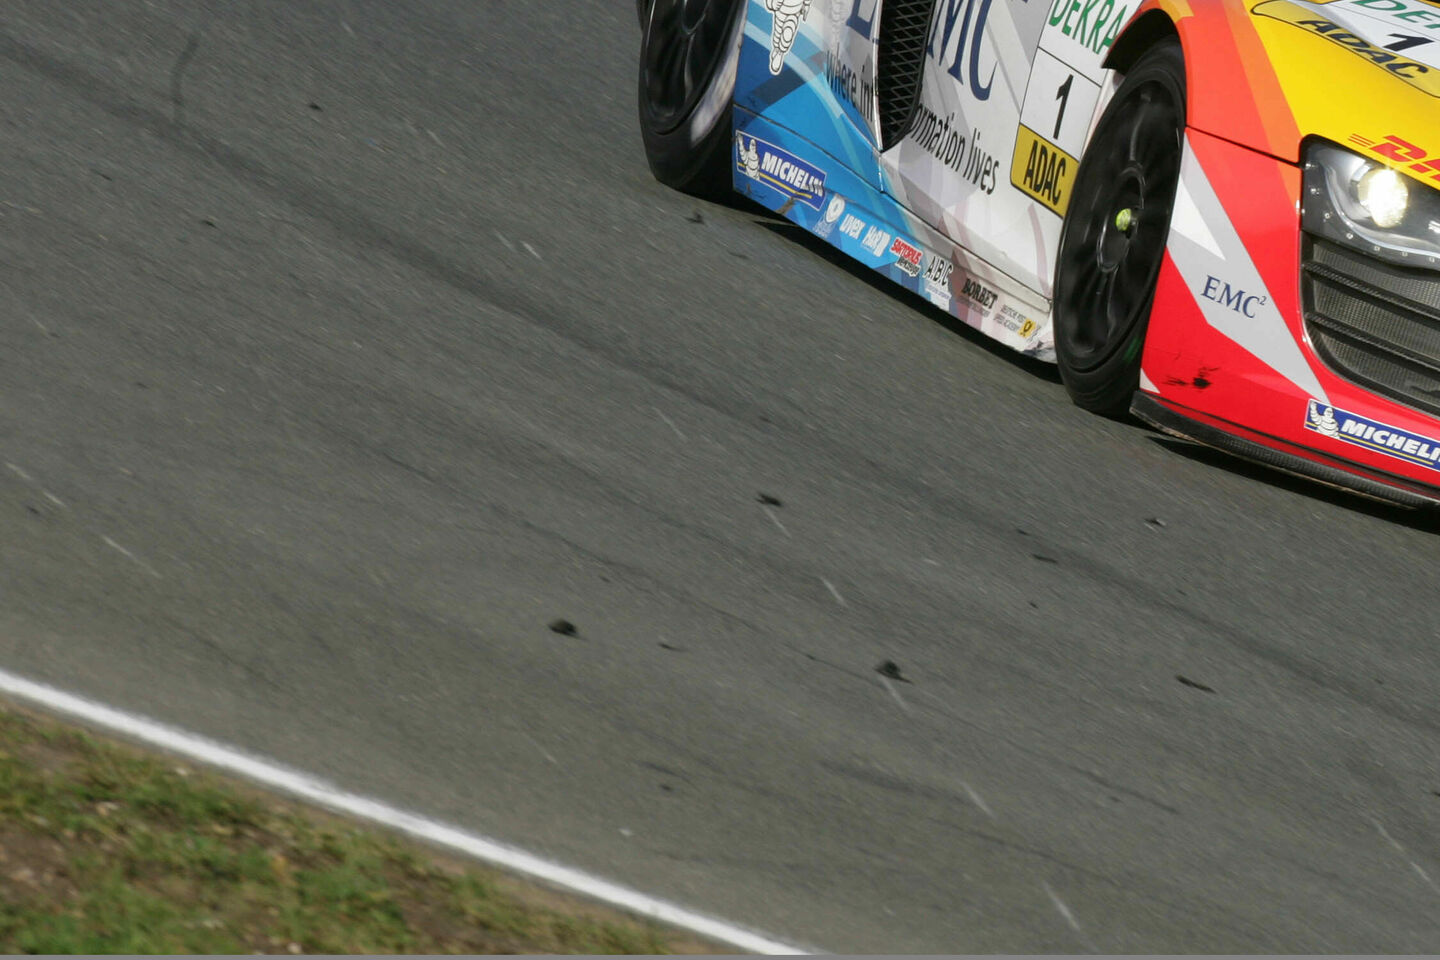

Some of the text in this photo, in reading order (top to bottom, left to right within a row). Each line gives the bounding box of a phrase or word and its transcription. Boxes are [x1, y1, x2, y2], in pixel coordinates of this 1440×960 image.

[1299, 19, 1430, 79] ADAC
[1383, 32, 1435, 53] 1
[1055, 74, 1074, 140] 1
[760, 151, 824, 197] MICHELIN
[962, 127, 1000, 195] lives
[1023, 139, 1066, 206] ADAC
[962, 277, 999, 310] BORBET
